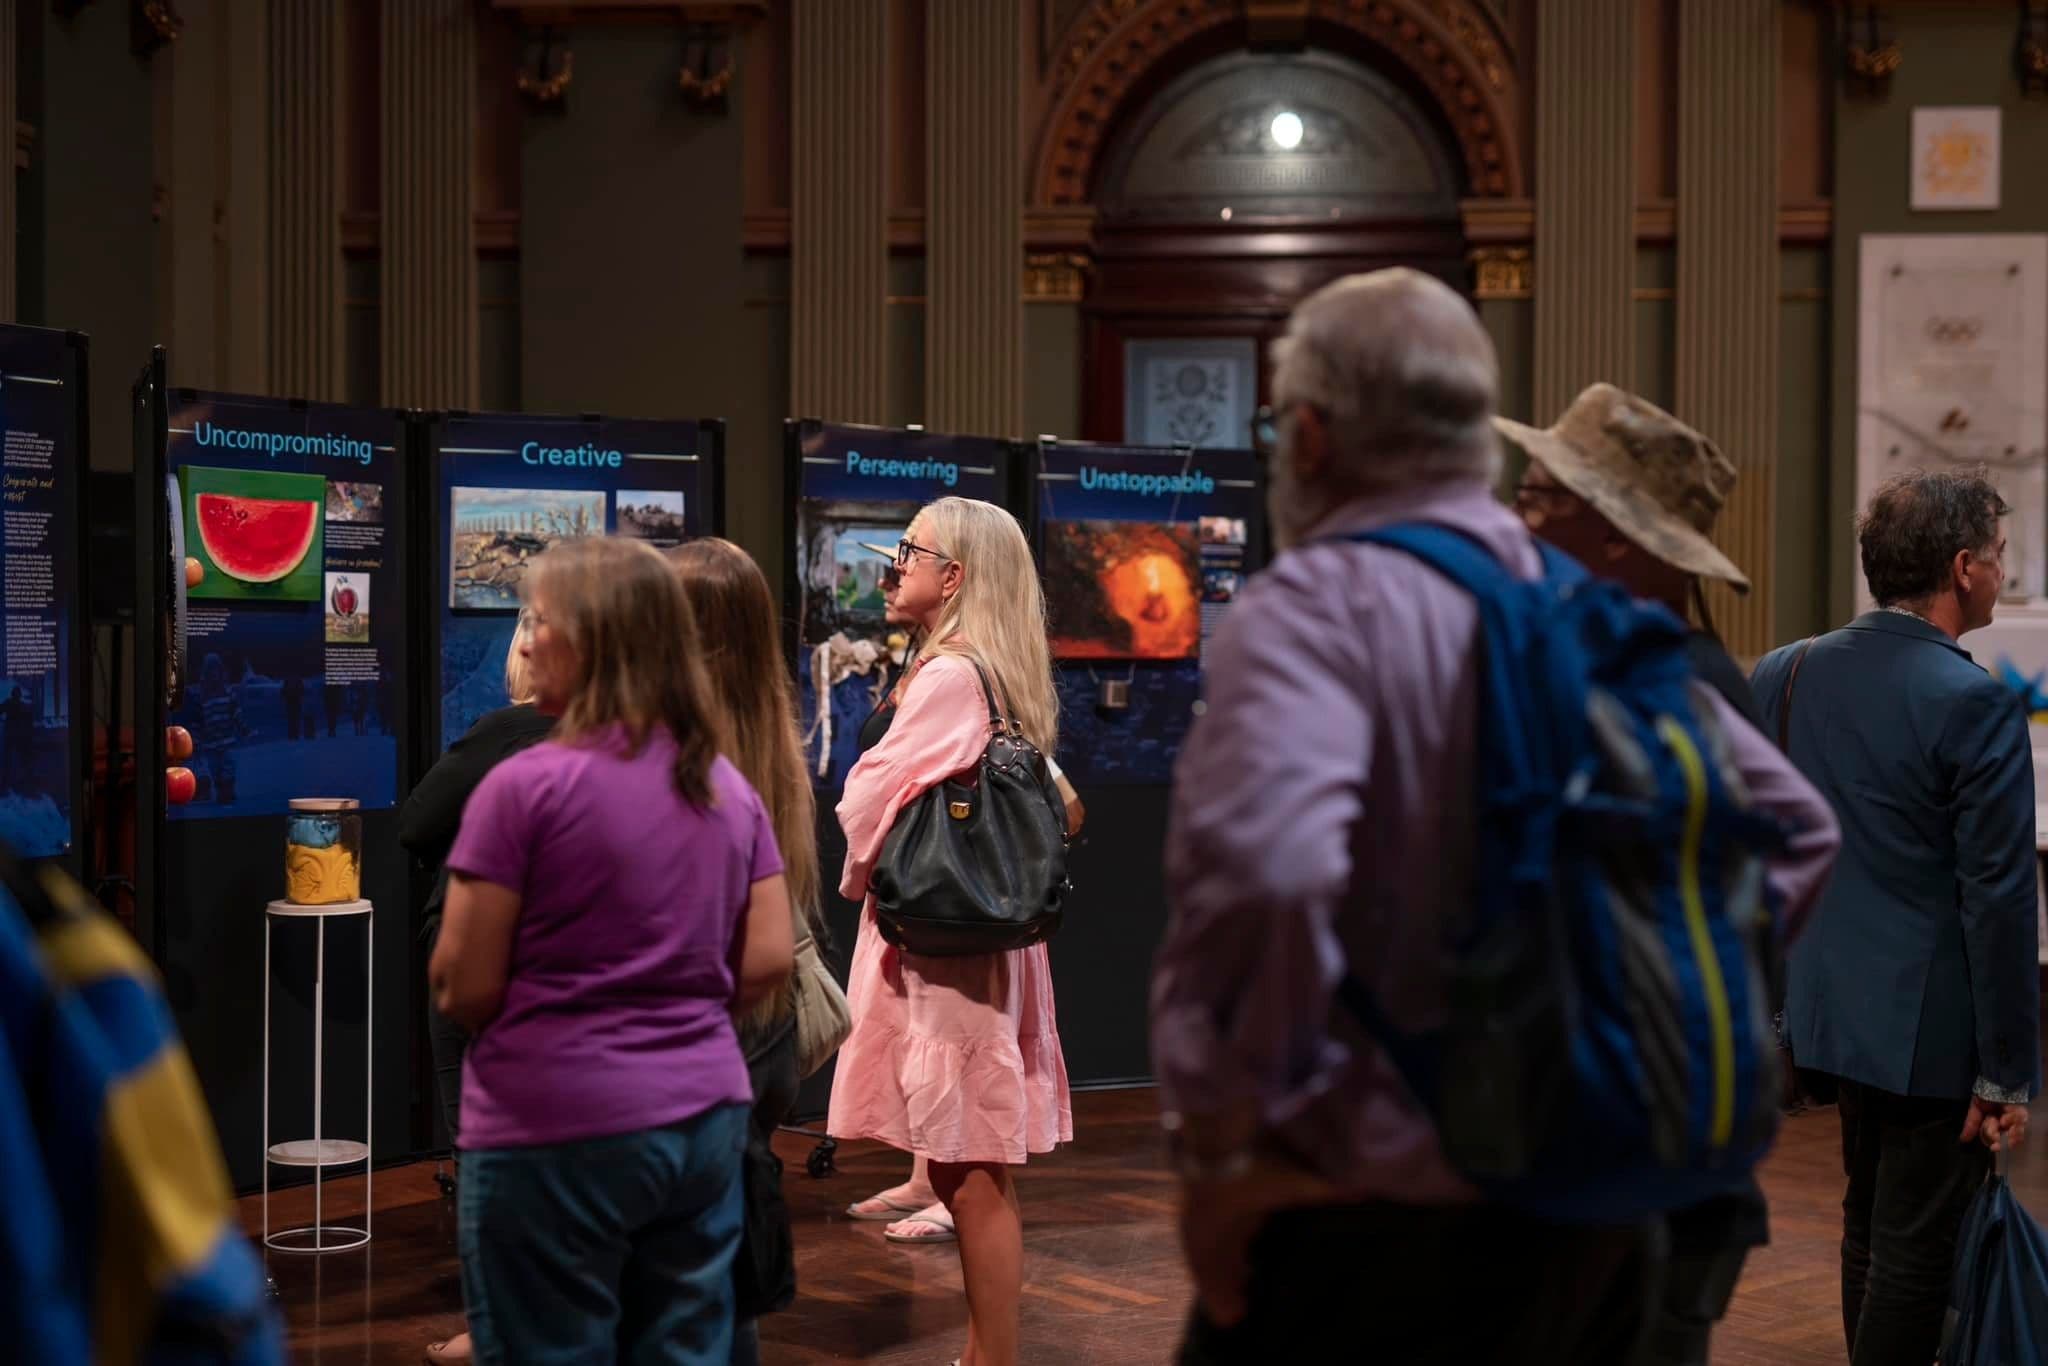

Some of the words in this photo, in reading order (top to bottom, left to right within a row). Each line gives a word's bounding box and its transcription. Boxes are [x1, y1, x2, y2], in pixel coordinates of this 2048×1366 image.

[195, 421, 372, 465] Uncompromising
[522, 441, 622, 468] Creative
[846, 450, 958, 487] Persevering
[1080, 465, 1214, 497] Unstoppable
